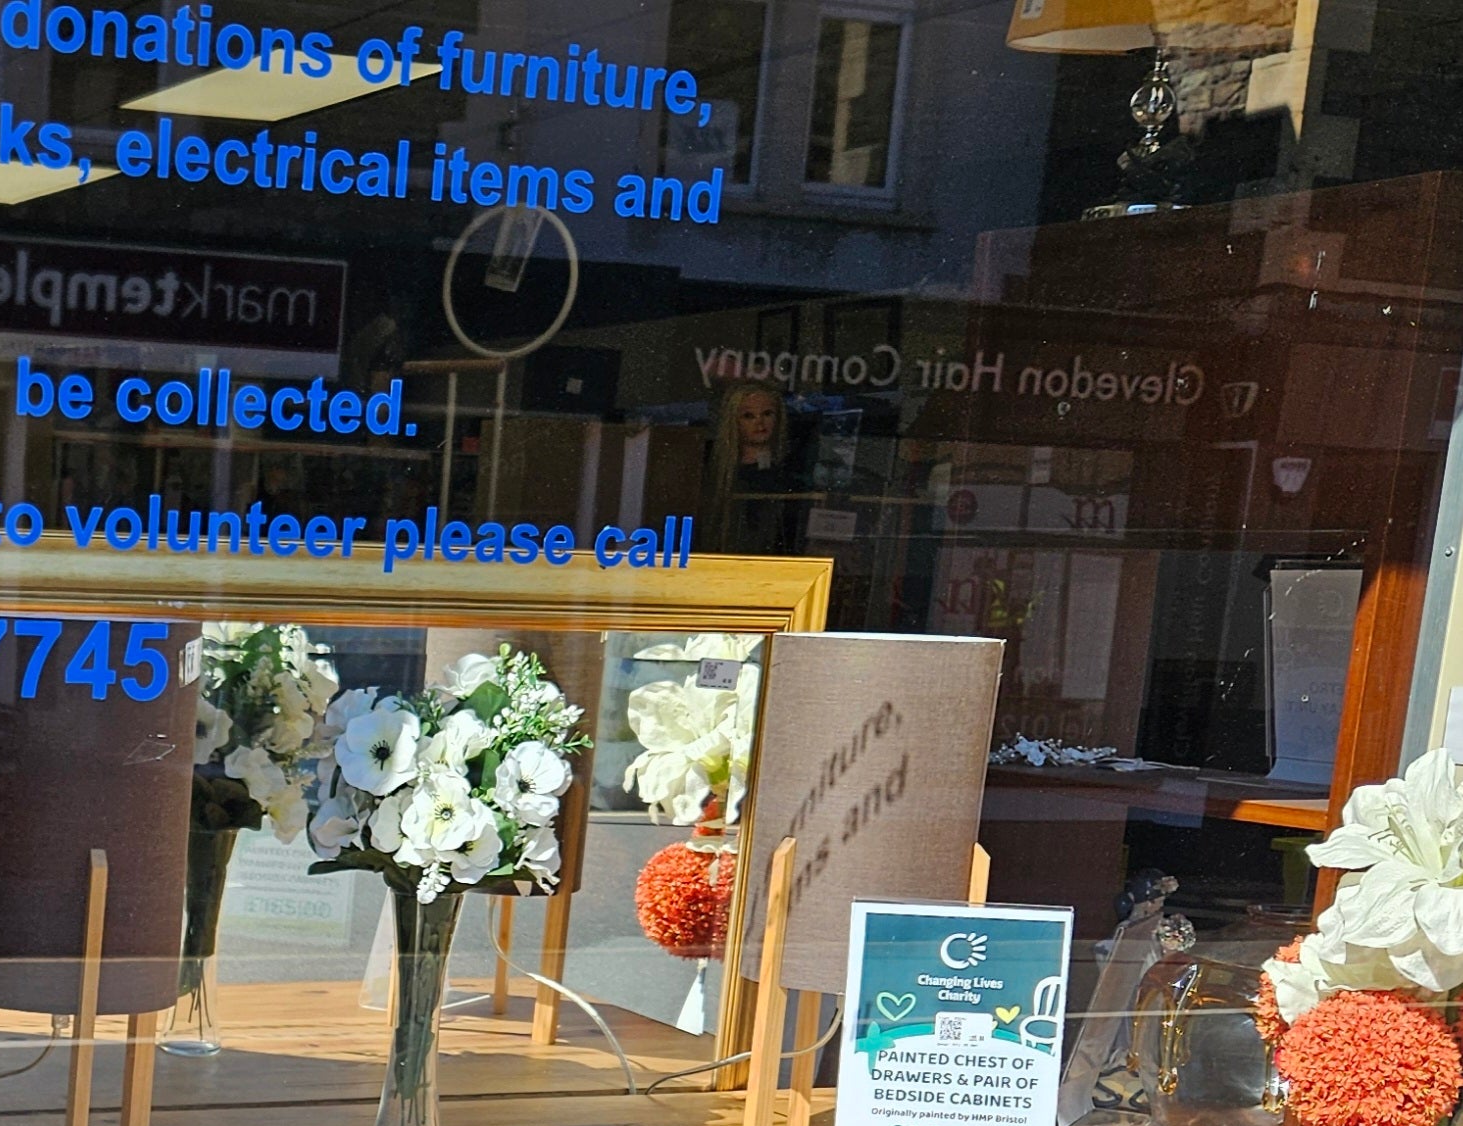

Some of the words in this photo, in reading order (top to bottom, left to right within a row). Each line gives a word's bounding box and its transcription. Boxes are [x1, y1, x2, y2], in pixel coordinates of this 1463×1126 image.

[0, 0, 334, 80] donations
[357, 25, 425, 88] of
[437, 30, 714, 129] furniture,
[116, 117, 412, 200] electrical
[431, 141, 597, 216] items
[613, 167, 726, 225] and
[16, 355, 96, 422] be
[116, 366, 420, 438] collected.
[65, 493, 369, 559] volunteer
[383, 506, 578, 575] please
[595, 515, 695, 569] call
[917, 974, 972, 990] Changing
[973, 977, 1004, 991] Lives
[937, 989, 982, 1005] Charity
[877, 1049, 950, 1067] PAINTED
[953, 1053, 1008, 1069] CHEST
[1011, 1056, 1036, 1071] OF
[870, 1068, 953, 1087] DRAWERS
[956, 1074, 969, 1087] &
[972, 1074, 1011, 1090] PAIR
[1015, 1076, 1039, 1091] OF
[873, 1088, 946, 1105] BEDSIDE
[949, 1091, 1033, 1110] CABINETS
[870, 1106, 918, 1120] Originally
[918, 1110, 956, 1122] painted
[957, 1111, 970, 1122] by
[970, 1113, 994, 1123] HMP
[995, 1114, 1028, 1125] Bristol
